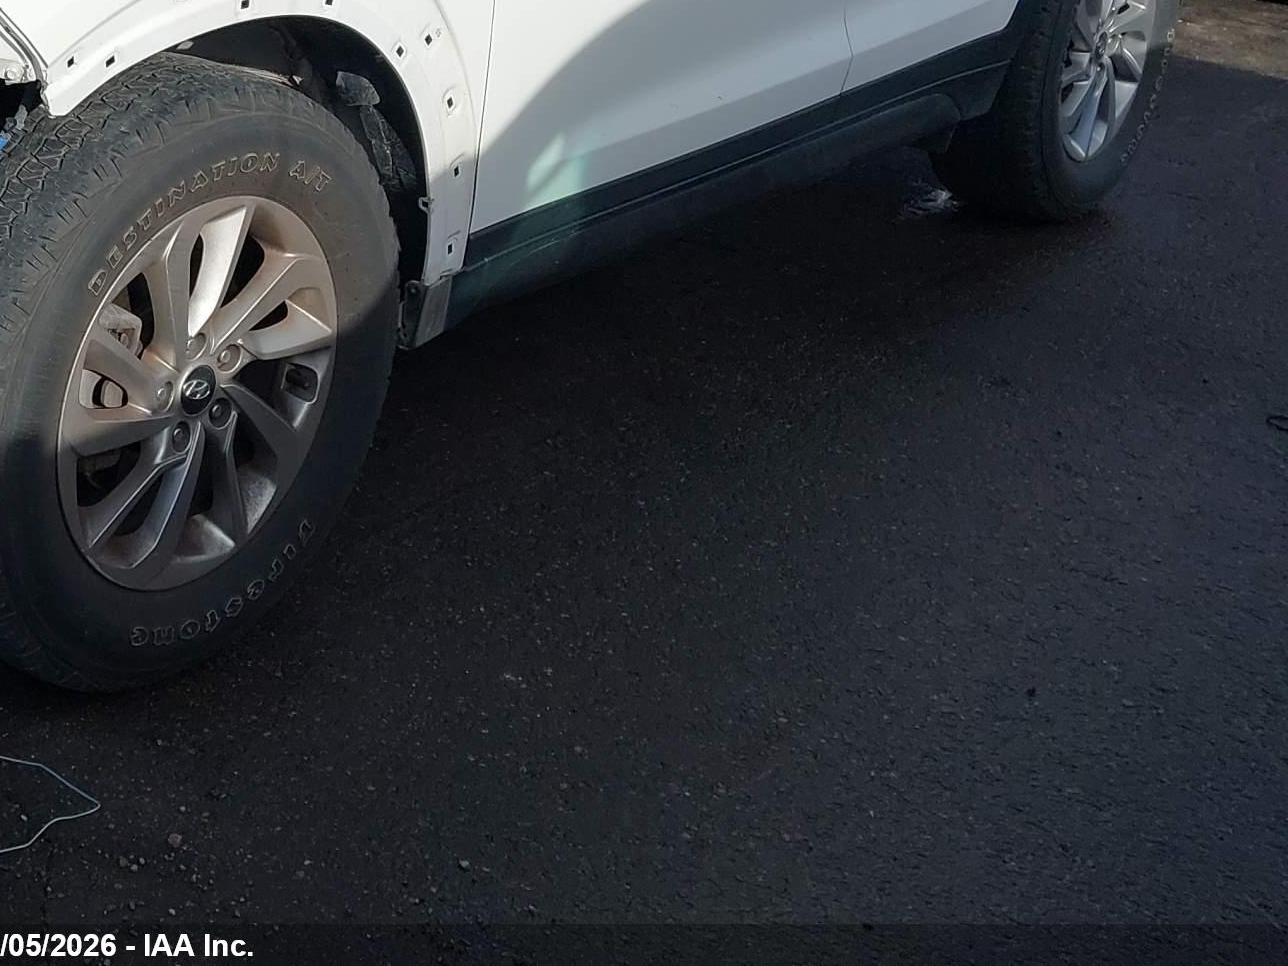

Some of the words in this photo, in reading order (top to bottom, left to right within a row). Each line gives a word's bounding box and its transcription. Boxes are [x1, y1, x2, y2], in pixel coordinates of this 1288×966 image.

[87, 151, 281, 298] DESTINATION
[287, 160, 333, 194] A/T
[129, 518, 317, 647] Firestone
